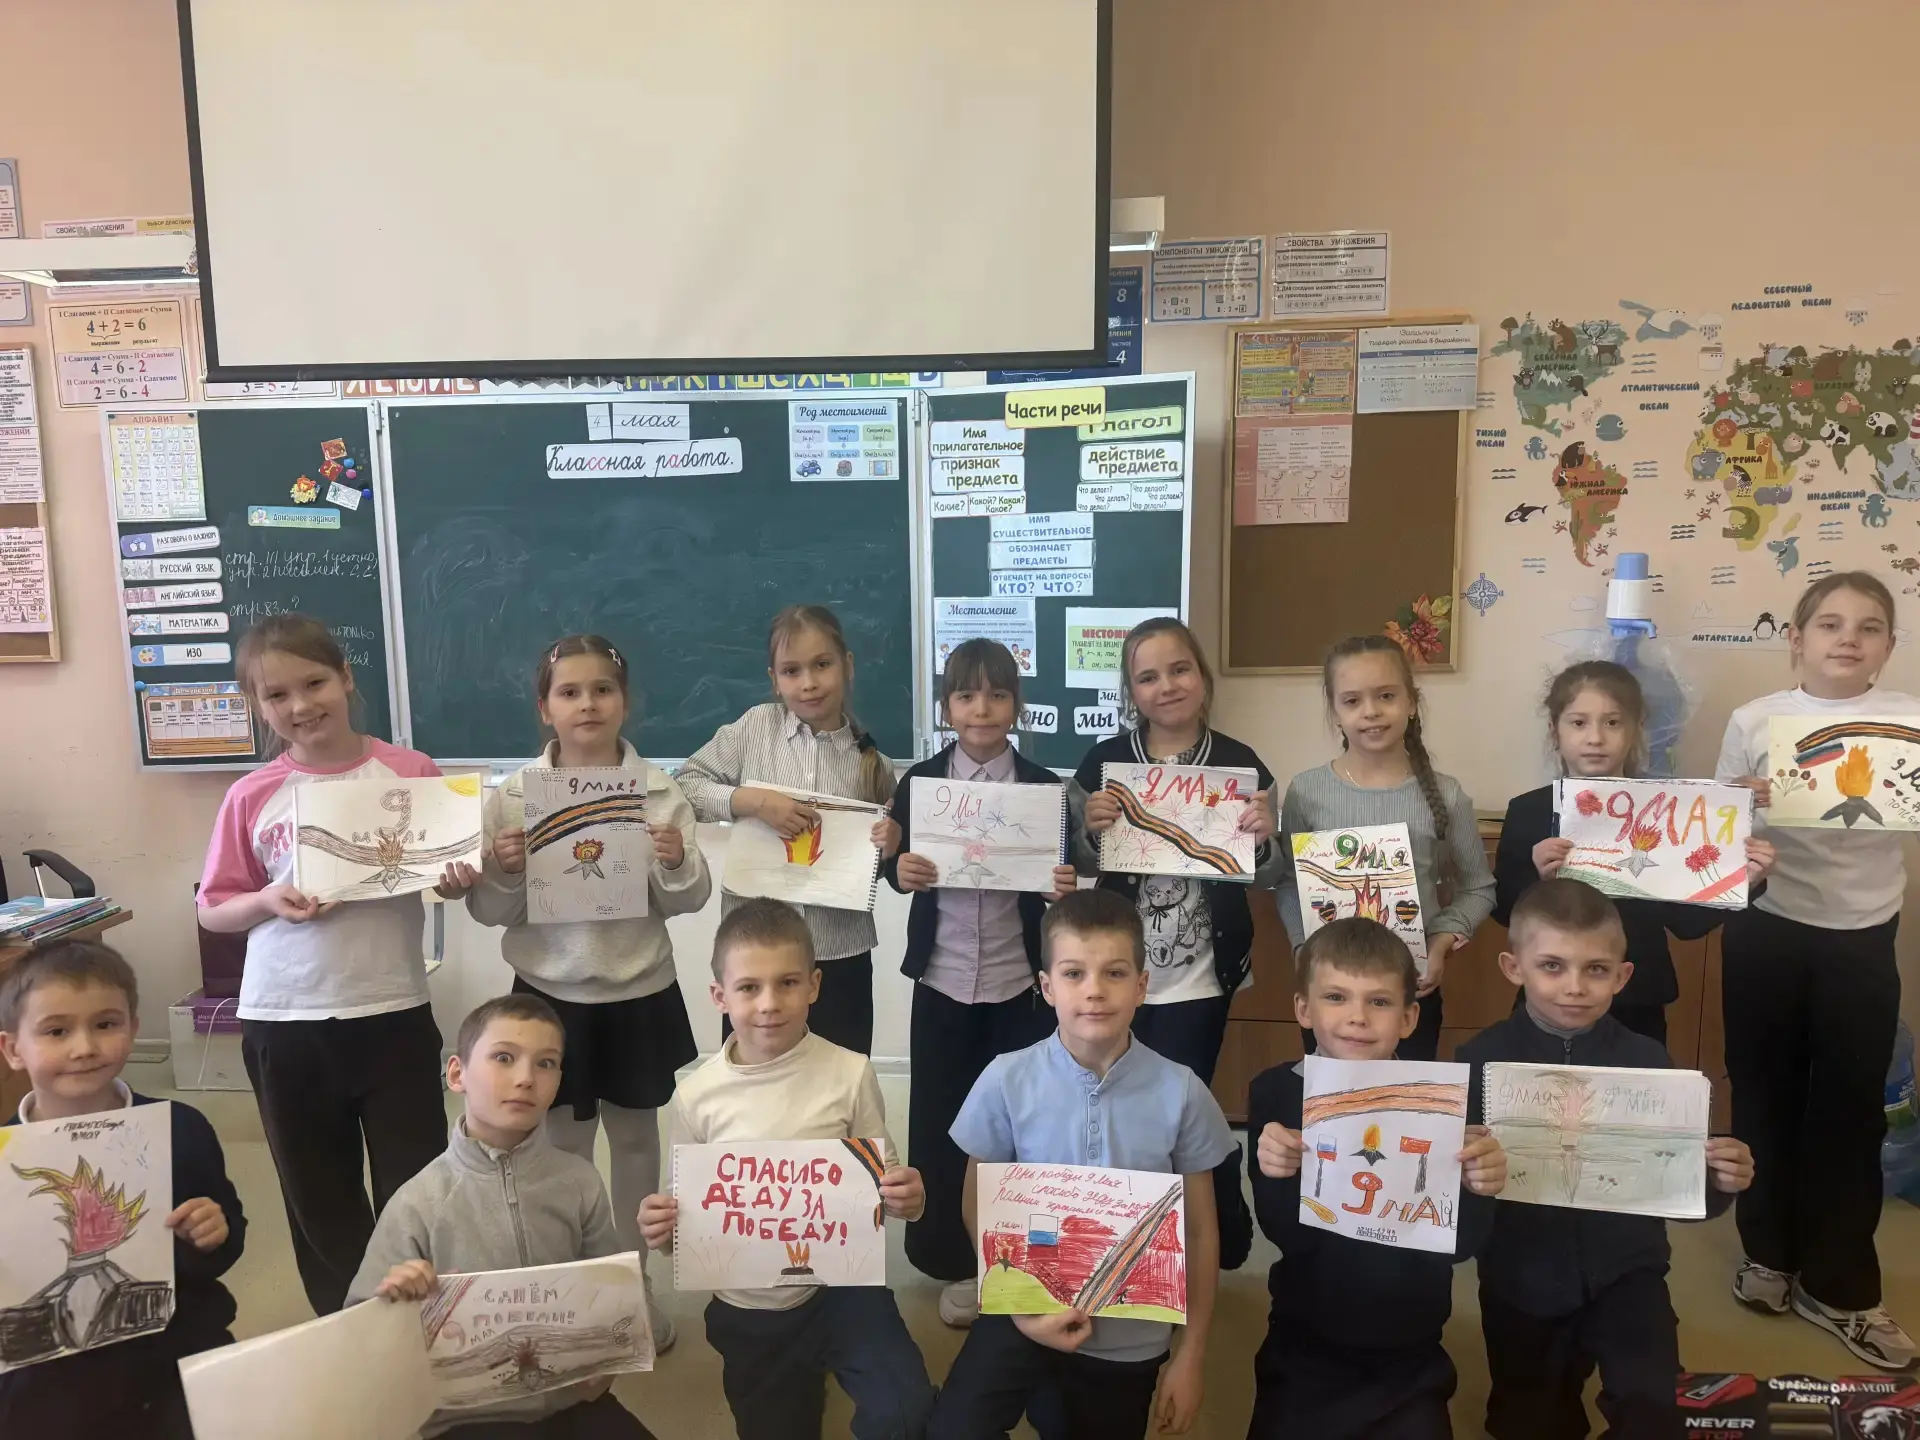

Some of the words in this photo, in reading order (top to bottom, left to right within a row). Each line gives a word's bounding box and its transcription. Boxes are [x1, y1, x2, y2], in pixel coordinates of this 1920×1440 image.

[1287, 239, 1324, 247] СВОЙСТВА
[1331, 237, 1376, 246] УМНОЖЕНИЯ
[1763, 283, 1813, 295] СЕВЕРНЫЙ
[1116, 288, 1127, 303] 8
[150, 305, 173, 314] Сумма
[1731, 299, 1791, 311] ЛЕДОВИТЫЙ
[1801, 298, 1832, 307] ОКЕАН
[86, 320, 95, 333] 4
[112, 319, 120, 332] 2
[138, 317, 146, 331] 6
[107, 353, 129, 361] Сумма
[1116, 349, 1127, 364] 4
[1533, 352, 1578, 362] СЕВЕРНАЯ
[91, 362, 99, 375] 4
[116, 360, 125, 374] 6
[138, 360, 147, 373] 2
[1533, 362, 1577, 372] АМЕРИКА
[112, 376, 134, 385] Сумма
[93, 386, 102, 400] 2
[120, 385, 128, 399] 6
[141, 384, 150, 397] 4
[1621, 381, 1700, 393] АТЛАНТИЧЕСКИЙ
[1008, 403, 1057, 420] Части
[1061, 402, 1102, 421] речи
[1639, 402, 1670, 411] ОКЕАН
[799, 406, 817, 421] Род
[819, 405, 887, 417] местоимений
[132, 415, 175, 424] АЛФАВИТ
[620, 413, 680, 429] мая
[963, 427, 987, 439] Имя
[1475, 427, 1507, 438] ТИХИЙ
[932, 442, 1023, 454] прилагательное
[1476, 438, 1505, 448] ОКЕАН
[547, 445, 646, 472] Классная
[654, 440, 735, 478] работа.
[1088, 445, 1165, 463] действие
[1725, 455, 1763, 465] АФРИКА
[941, 457, 1000, 473] признак
[1098, 459, 1179, 478] предмета
[947, 473, 1018, 490] предмета
[1569, 479, 1606, 488] ЮЖНАЯ
[1586, 487, 1629, 496] АМЕРИКА
[1807, 489, 1866, 501] ИНДИЙСКИЙ
[933, 500, 965, 513] Какие?
[969, 496, 997, 506] Какой?
[998, 495, 1026, 505] Какая?
[985, 503, 1013, 514] Какое?
[1820, 502, 1851, 512] ОКЕАН
[273, 513, 307, 523] Домашнее
[309, 514, 337, 524] задание
[1028, 515, 1051, 524] ИМЯ
[157, 534, 188, 545] РАЗГОВОРЫ
[188, 533, 193, 541] О
[193, 531, 216, 541] ВАЖНОМ
[993, 526, 1092, 539] СУЩЕСТВИТЕЛЬНОЕ
[1008, 543, 1072, 553] ОБОЗНАЧАЕТ
[1012, 556, 1068, 566] ПРЕДМЕТЫ
[160, 562, 192, 573] РУССКИЙ
[196, 562, 215, 573] ЯЗЫК
[992, 573, 1033, 582] ОТВЕЧАЕТ
[1035, 572, 1047, 581] НА
[1050, 572, 1092, 581] ВОПРОСЫ
[998, 581, 1035, 595] КТО?
[1043, 580, 1083, 594] ЧТО?
[160, 589, 197, 600] АНГЛИЙСКИЙ
[198, 588, 217, 598] ЯЗЫК
[948, 603, 1018, 617] Местоимение
[168, 617, 220, 628] МАТЕМАТИКА
[1691, 634, 1753, 643] АНТАРКТИДА
[186, 648, 202, 658] ИЗО
[569, 777, 579, 794] 9
[933, 785, 952, 817] 9
[380, 788, 412, 836] 9
[1606, 790, 1635, 842] 9
[1629, 791, 1738, 847] МАЯ
[717, 1152, 843, 1186] СПАСИБО
[1085, 1171, 1092, 1182] 9
[1342, 1171, 1383, 1216] 9
[701, 1183, 792, 1211] ДЕДУ
[801, 1188, 825, 1220] ЗА
[722, 1211, 848, 1246] ПОБЕДУ!
[1685, 1417, 1756, 1429] NEVER
